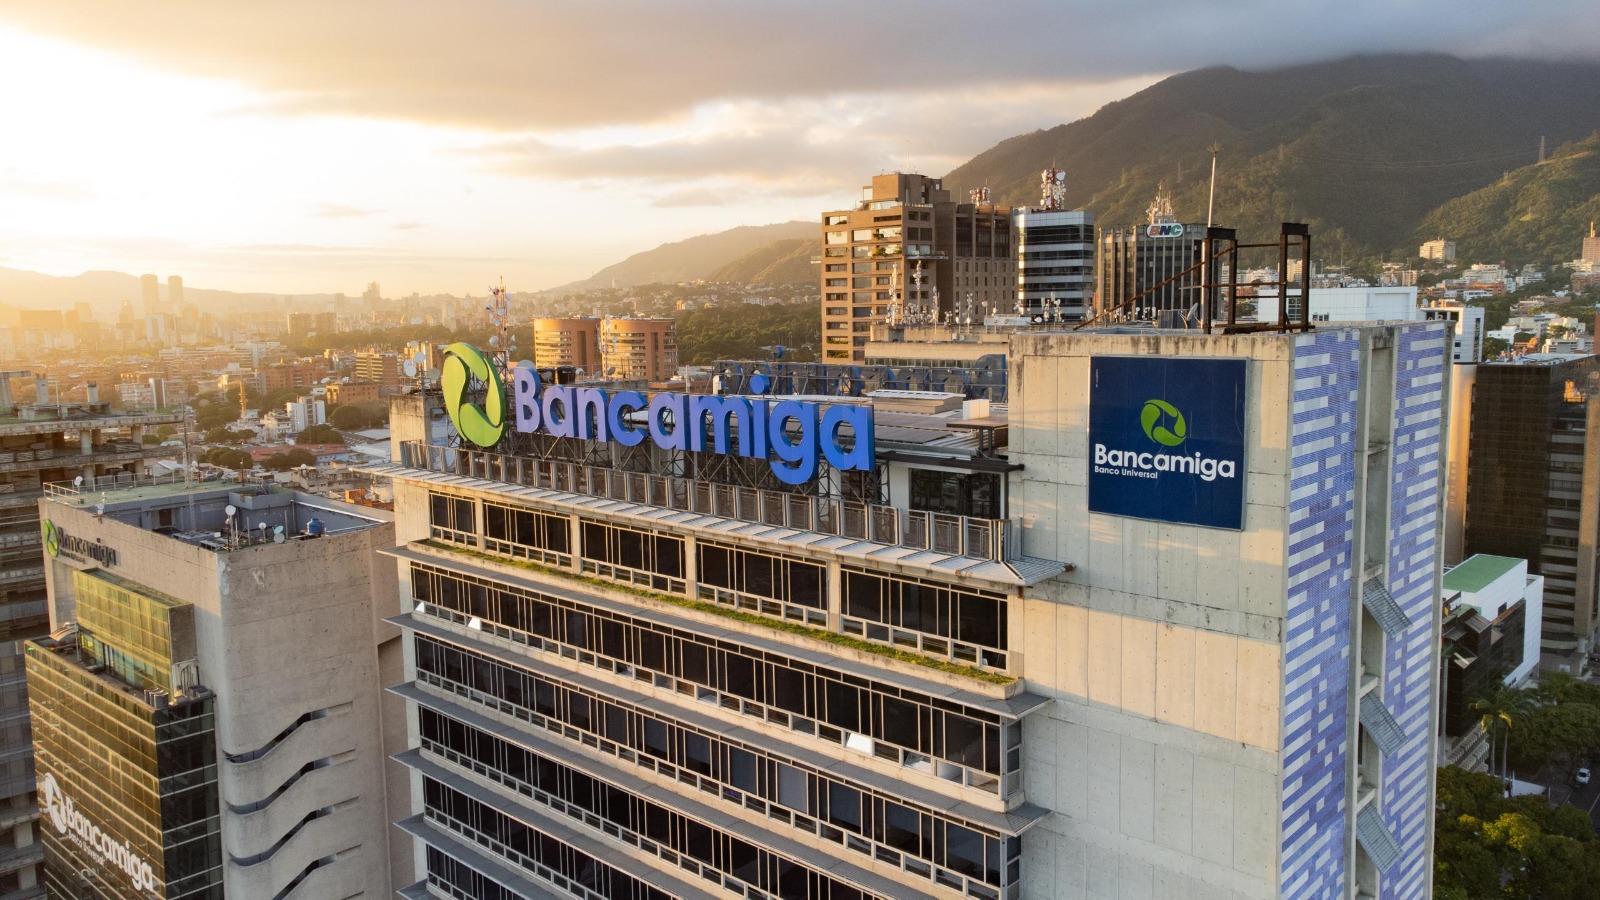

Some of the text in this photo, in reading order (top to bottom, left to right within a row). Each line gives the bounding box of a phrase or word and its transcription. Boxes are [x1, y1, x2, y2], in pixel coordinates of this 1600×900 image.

[1149, 225, 1182, 236] BNC
[514, 366, 875, 485] Bancamiga
[1094, 443, 1236, 482] Bancamiga
[1094, 465, 1158, 479] Banco Universal
[57, 526, 117, 567] Bancamiga
[65, 796, 154, 891] Bancamiga
